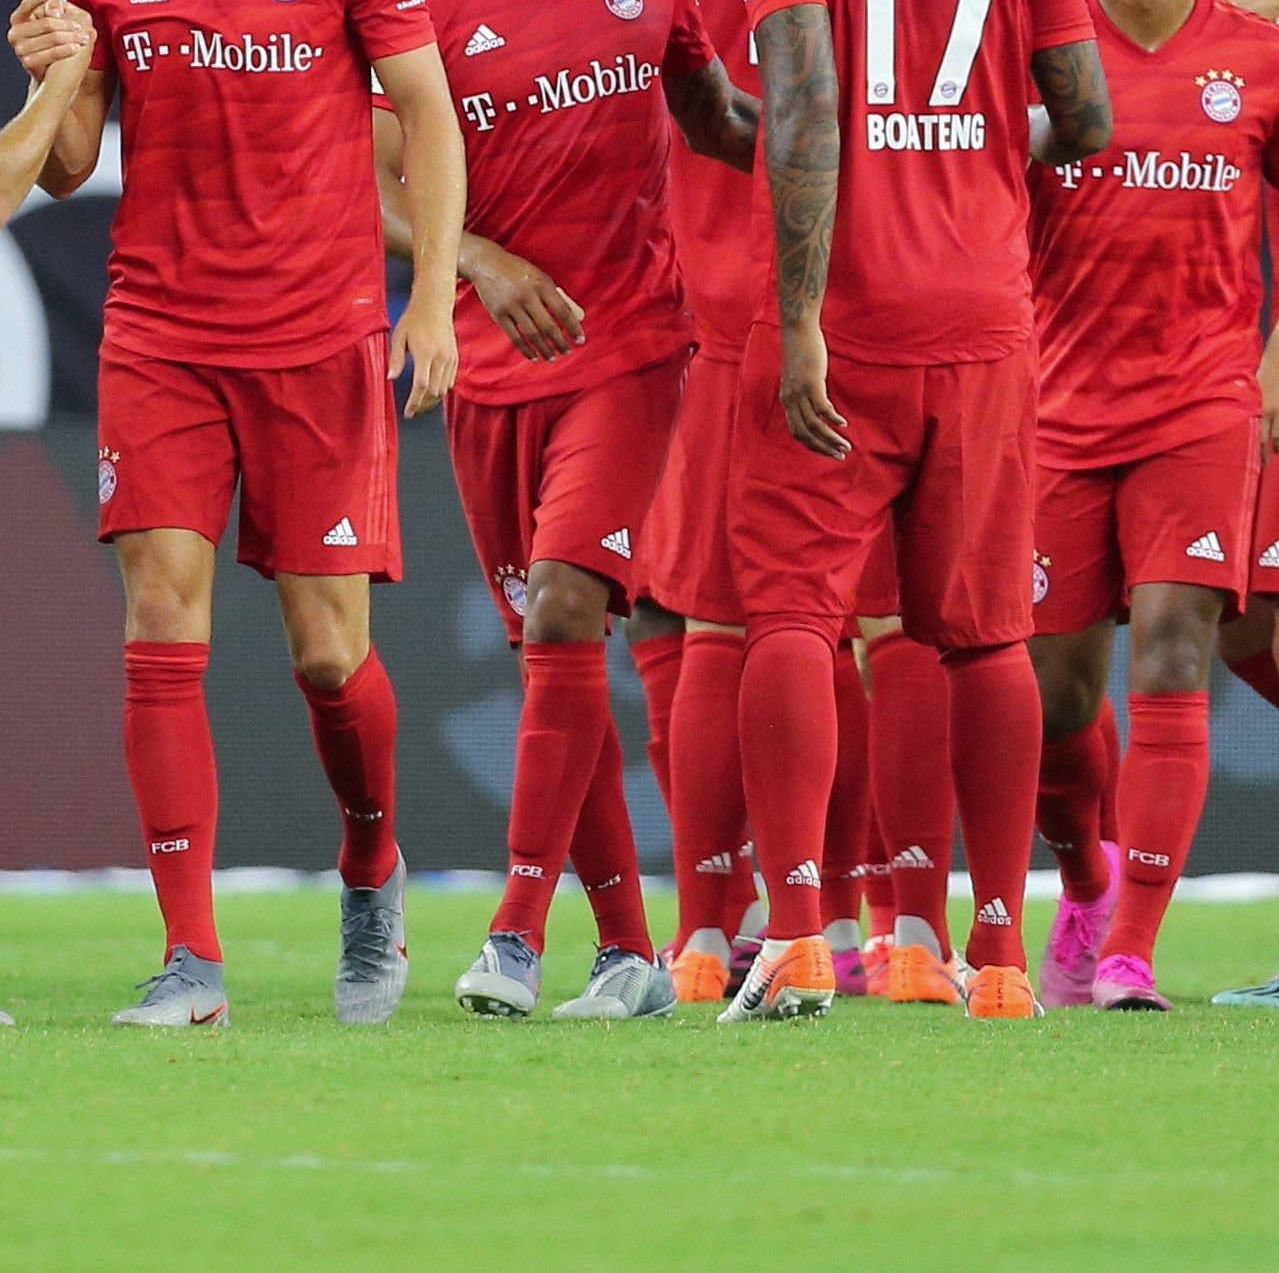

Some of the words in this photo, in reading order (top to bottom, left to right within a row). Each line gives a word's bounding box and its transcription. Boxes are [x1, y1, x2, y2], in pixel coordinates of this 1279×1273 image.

[464, 36, 506, 56] adidas
[867, 113, 985, 151] BOATENG
[323, 535, 357, 546] adidas
[151, 838, 190, 855] FCB
[1128, 848, 1170, 867] FCB
[510, 863, 544, 879] FCB
